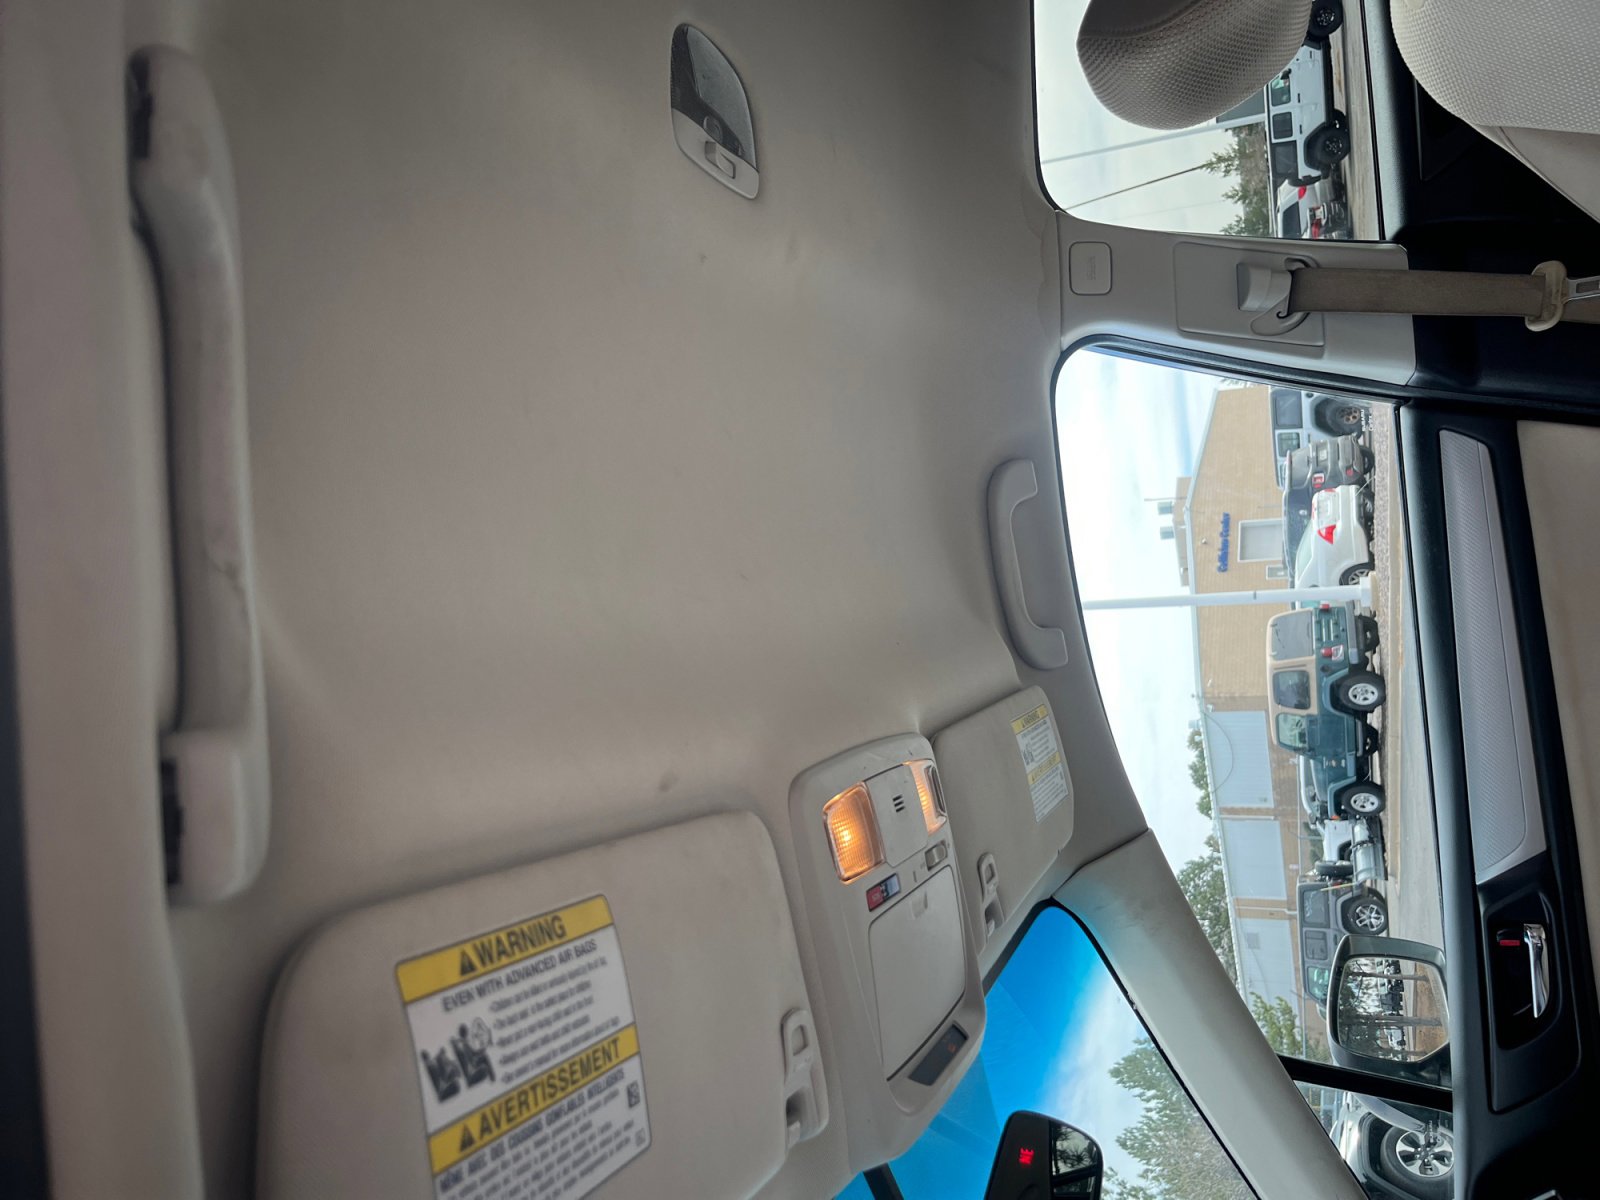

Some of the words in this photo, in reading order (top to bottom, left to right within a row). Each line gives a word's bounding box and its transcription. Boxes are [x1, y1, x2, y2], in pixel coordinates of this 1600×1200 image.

[442, 987, 475, 1013] EVEN
[475, 974, 505, 998] WITH
[505, 956, 557, 987] ADVANCED
[558, 948, 574, 967] AIR
[575, 938, 598, 957] BAGS
[473, 914, 567, 969] WARNING
[478, 1037, 622, 1141] AVERTISSEMENT
